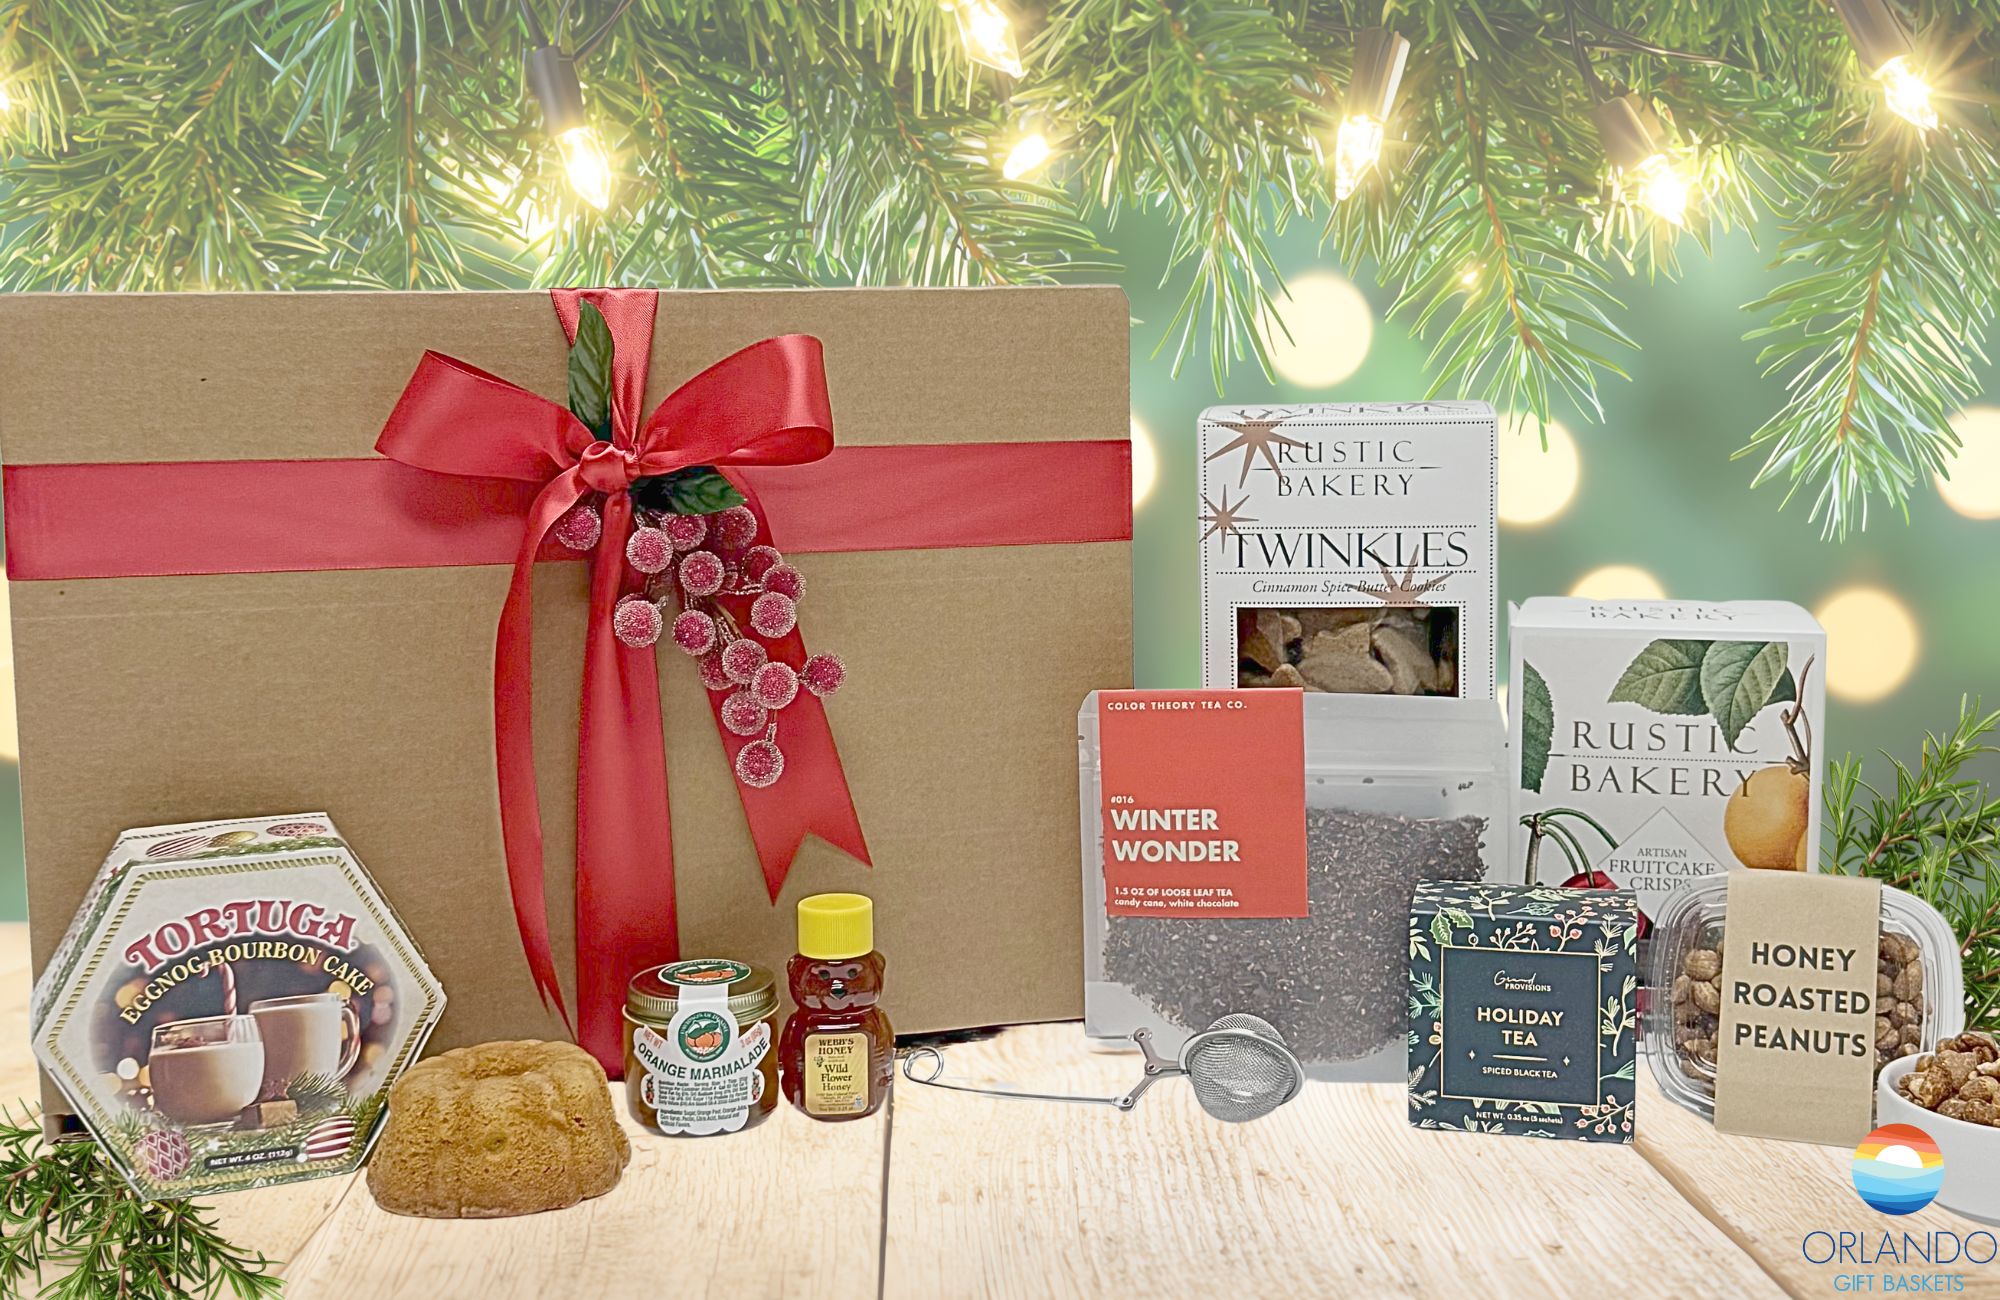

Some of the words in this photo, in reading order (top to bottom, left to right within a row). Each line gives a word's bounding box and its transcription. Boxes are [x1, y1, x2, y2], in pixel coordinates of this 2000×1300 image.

[1278, 440, 1415, 463] RUSTIC
[1277, 474, 1415, 497] BAKERY
[1227, 531, 1469, 569] TWINKLES
[1252, 580, 1318, 593] Cinnamon
[1321, 580, 1353, 596] Spice
[1357, 580, 1395, 592] Butter
[1400, 579, 1447, 592] Cookies
[1107, 702, 1146, 711] COLOR
[1151, 701, 1196, 710] THEORY
[1201, 701, 1222, 710] TEA
[1226, 700, 1248, 709] CO.
[1572, 720, 1759, 755] RUSTIC
[1570, 763, 1758, 798] BAKERY
[1110, 796, 1135, 804] #016
[1110, 808, 1219, 831] WINTER
[1111, 839, 1241, 863] WONDER
[1637, 847, 1688, 858] ARTISAN
[1609, 859, 1716, 876] FRUITCAKE
[1114, 886, 1129, 896] 1.5
[1130, 887, 1145, 896] OZ
[1146, 887, 1160, 896] OF
[1161, 888, 1191, 897] LOOSE
[1193, 888, 1214, 897] LEAF
[1216, 888, 1233, 897] TEA
[1630, 876, 1692, 892] CRISPS
[1114, 897, 1141, 908] candy
[1142, 899, 1167, 909] cane,
[1169, 898, 1195, 908] white
[1196, 898, 1240, 908] chocolate
[124, 899, 358, 973] TORTUGA
[1751, 941, 1857, 973] HONEY
[119, 956, 209, 1026] EGGNOG
[210, 942, 322, 968] BOURBON
[322, 955, 375, 997] CAKE
[1504, 983, 1552, 992] PROVISIONS
[1733, 981, 1871, 1015] ROASTED
[1477, 1006, 1564, 1027] HOLIDAY
[818, 1038, 854, 1047] WEBB'S
[1501, 1029, 1538, 1047] TEA
[1734, 1022, 1867, 1058] PEANUTS
[638, 1042, 687, 1080] ORANGE
[689, 1037, 768, 1081] MARMALADE
[818, 1046, 854, 1055] HONEY
[824, 1063, 848, 1073] Wild
[1482, 1066, 1513, 1077] SPICED
[1513, 1067, 1542, 1078] BLACK
[1542, 1069, 1558, 1079] TEA
[821, 1073, 853, 1082] Flower
[822, 1083, 852, 1092] Honey
[1475, 1111, 1491, 1119] NET
[1492, 1112, 1506, 1120] WT.
[209, 1157, 227, 1166] NET
